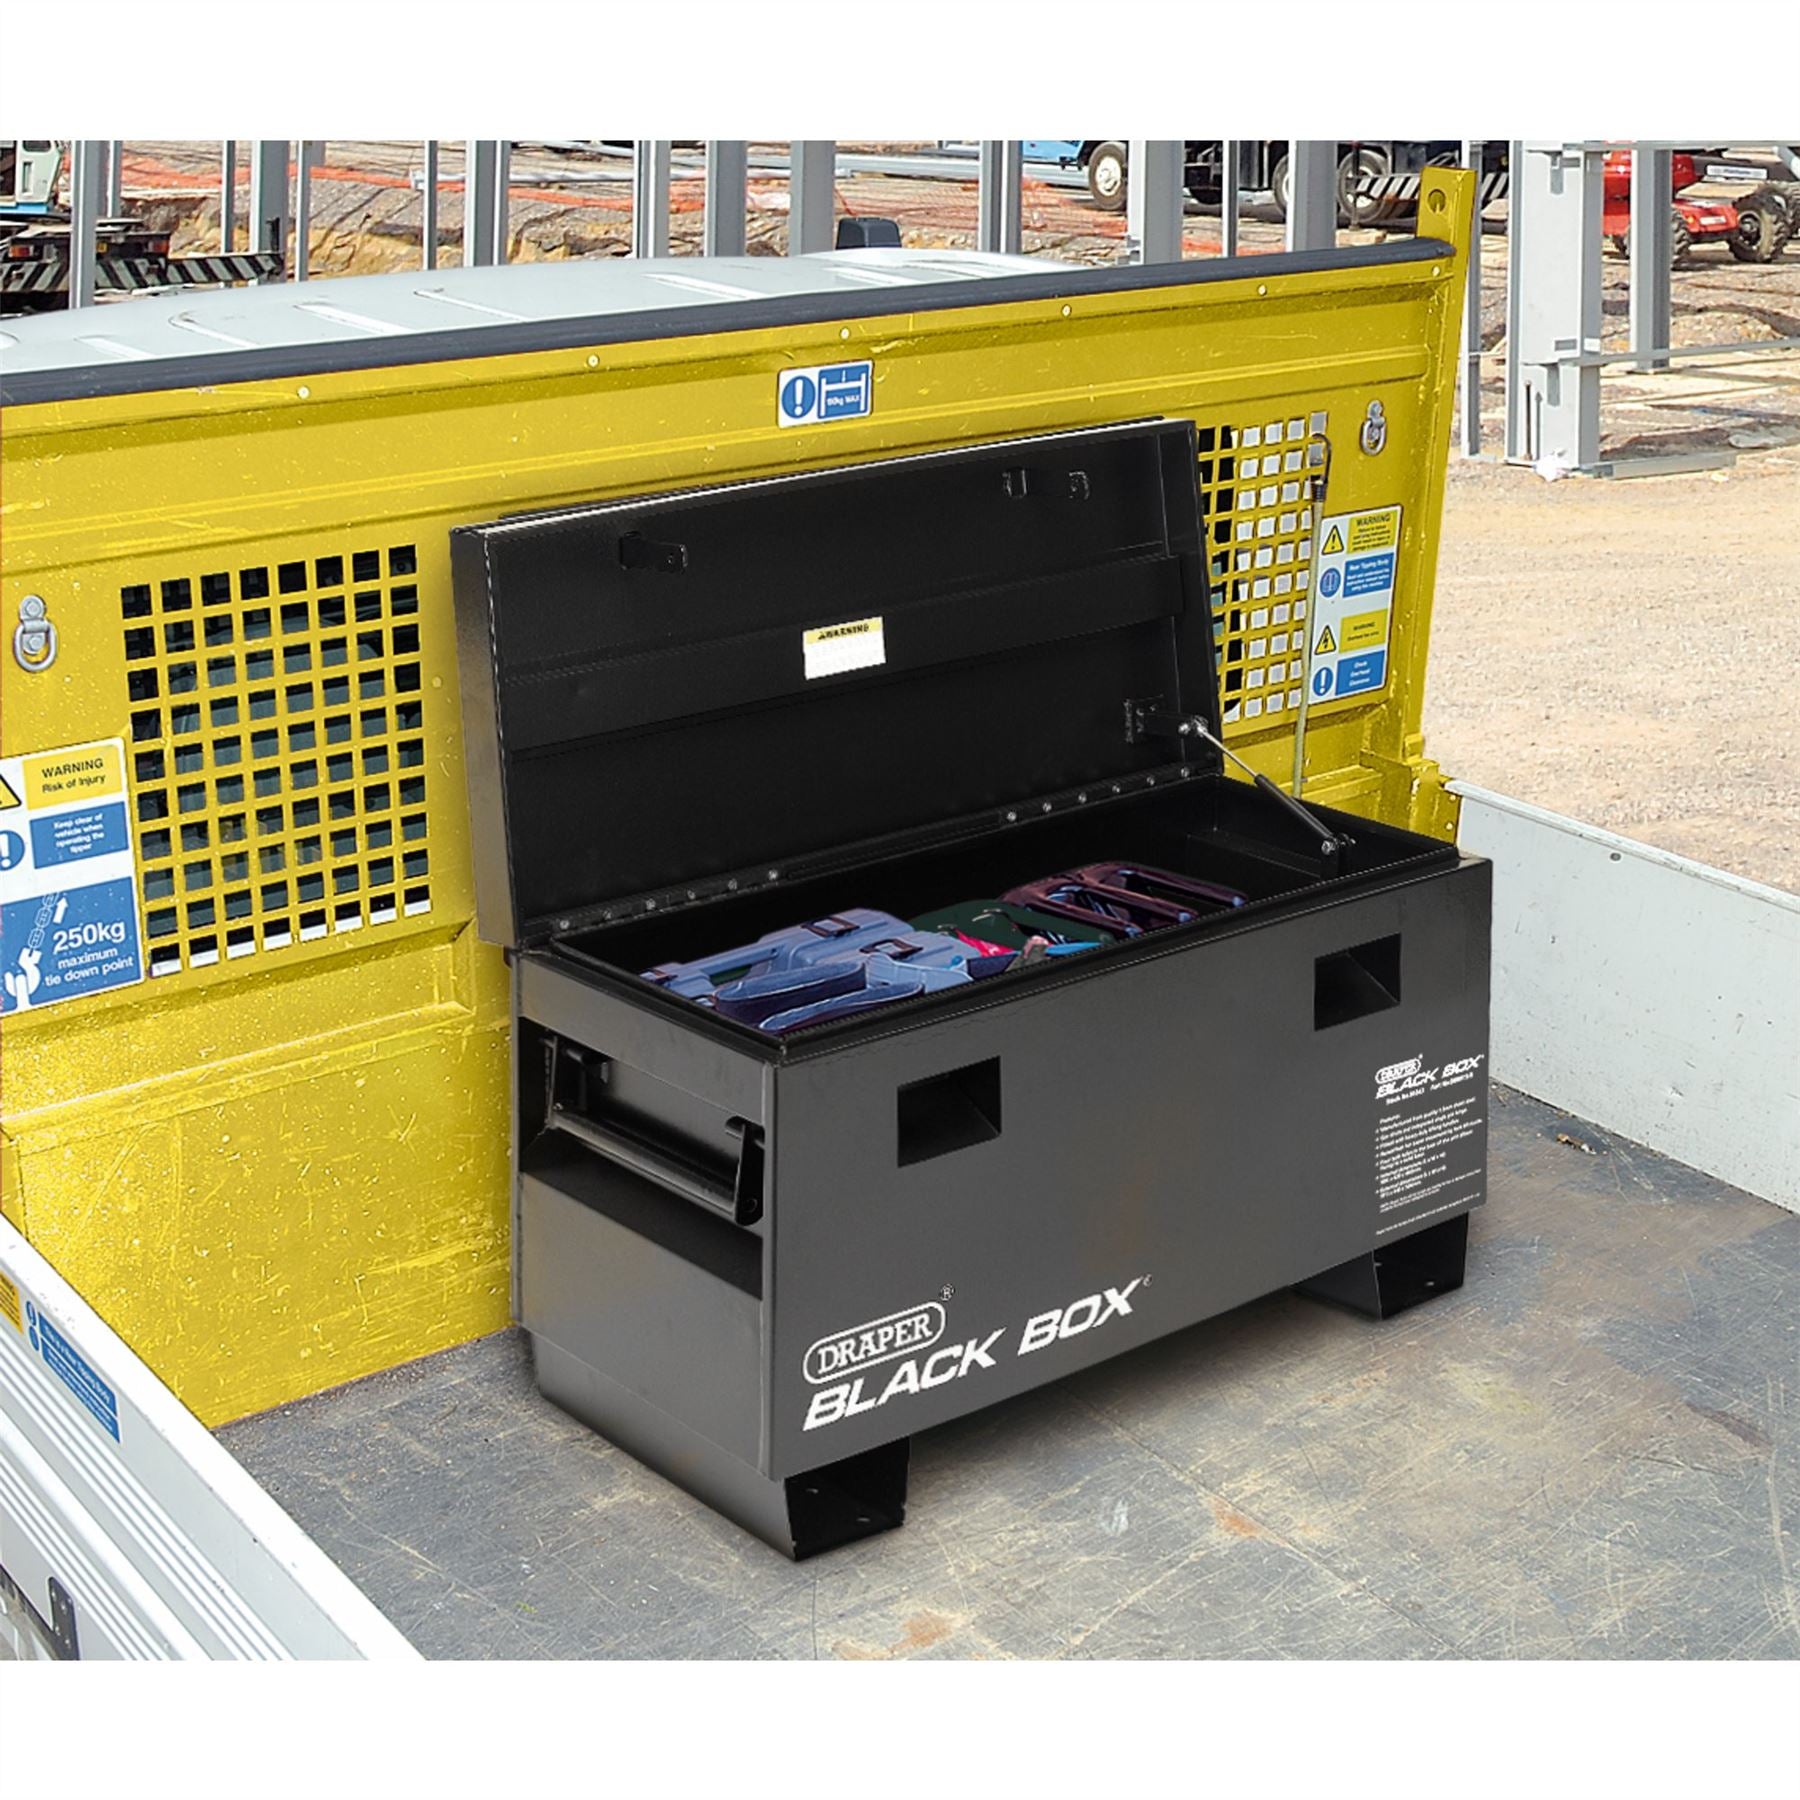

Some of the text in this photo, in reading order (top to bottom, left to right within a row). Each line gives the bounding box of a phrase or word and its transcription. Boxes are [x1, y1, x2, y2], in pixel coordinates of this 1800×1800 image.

[1356, 512, 1391, 526] WARNING
[42, 758, 103, 778] WARNING
[42, 774, 106, 793] Risk of Injury
[53, 812, 104, 830] Keep clear of
[54, 823, 104, 839] vehicle when
[92, 831, 105, 840] the
[52, 921, 126, 955] 250kg
[58, 947, 118, 970] maximum
[45, 956, 134, 987] tie down point
[1375, 1067, 1439, 1099] BLACK
[1441, 1054, 1482, 1079] BOX
[817, 1311, 933, 1374] DRAPER
[802, 1276, 1144, 1431] BLACK BOX
